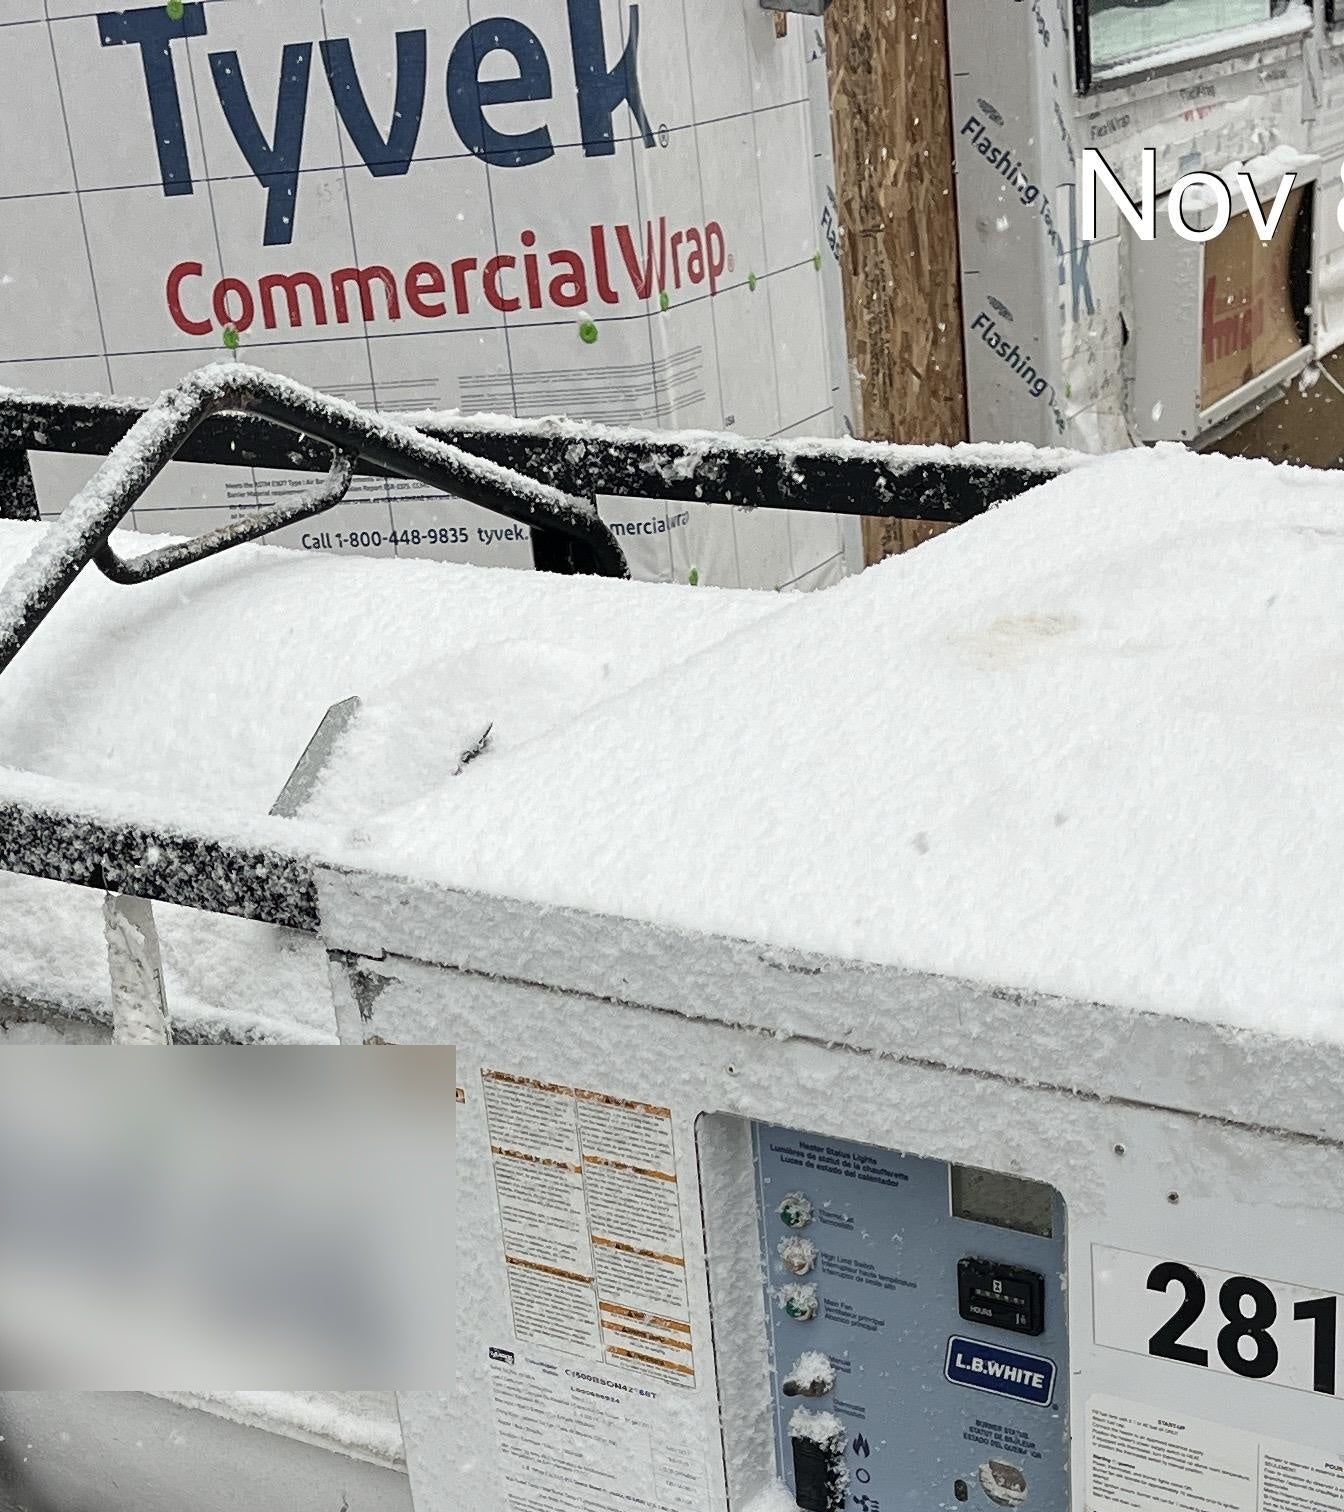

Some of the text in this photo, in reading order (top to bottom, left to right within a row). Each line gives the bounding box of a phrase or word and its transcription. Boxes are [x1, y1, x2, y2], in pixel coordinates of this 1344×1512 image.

[97, 0, 657, 246] Tyvek
[960, 116, 1039, 205] Flashing
[166, 217, 726, 336] CommercialWrap
[970, 312, 1048, 398] Flashing
[302, 533, 333, 550] Call
[337, 527, 469, 549] 1-800-448-9835
[955, 1352, 1046, 1389] L.B.WHITE
